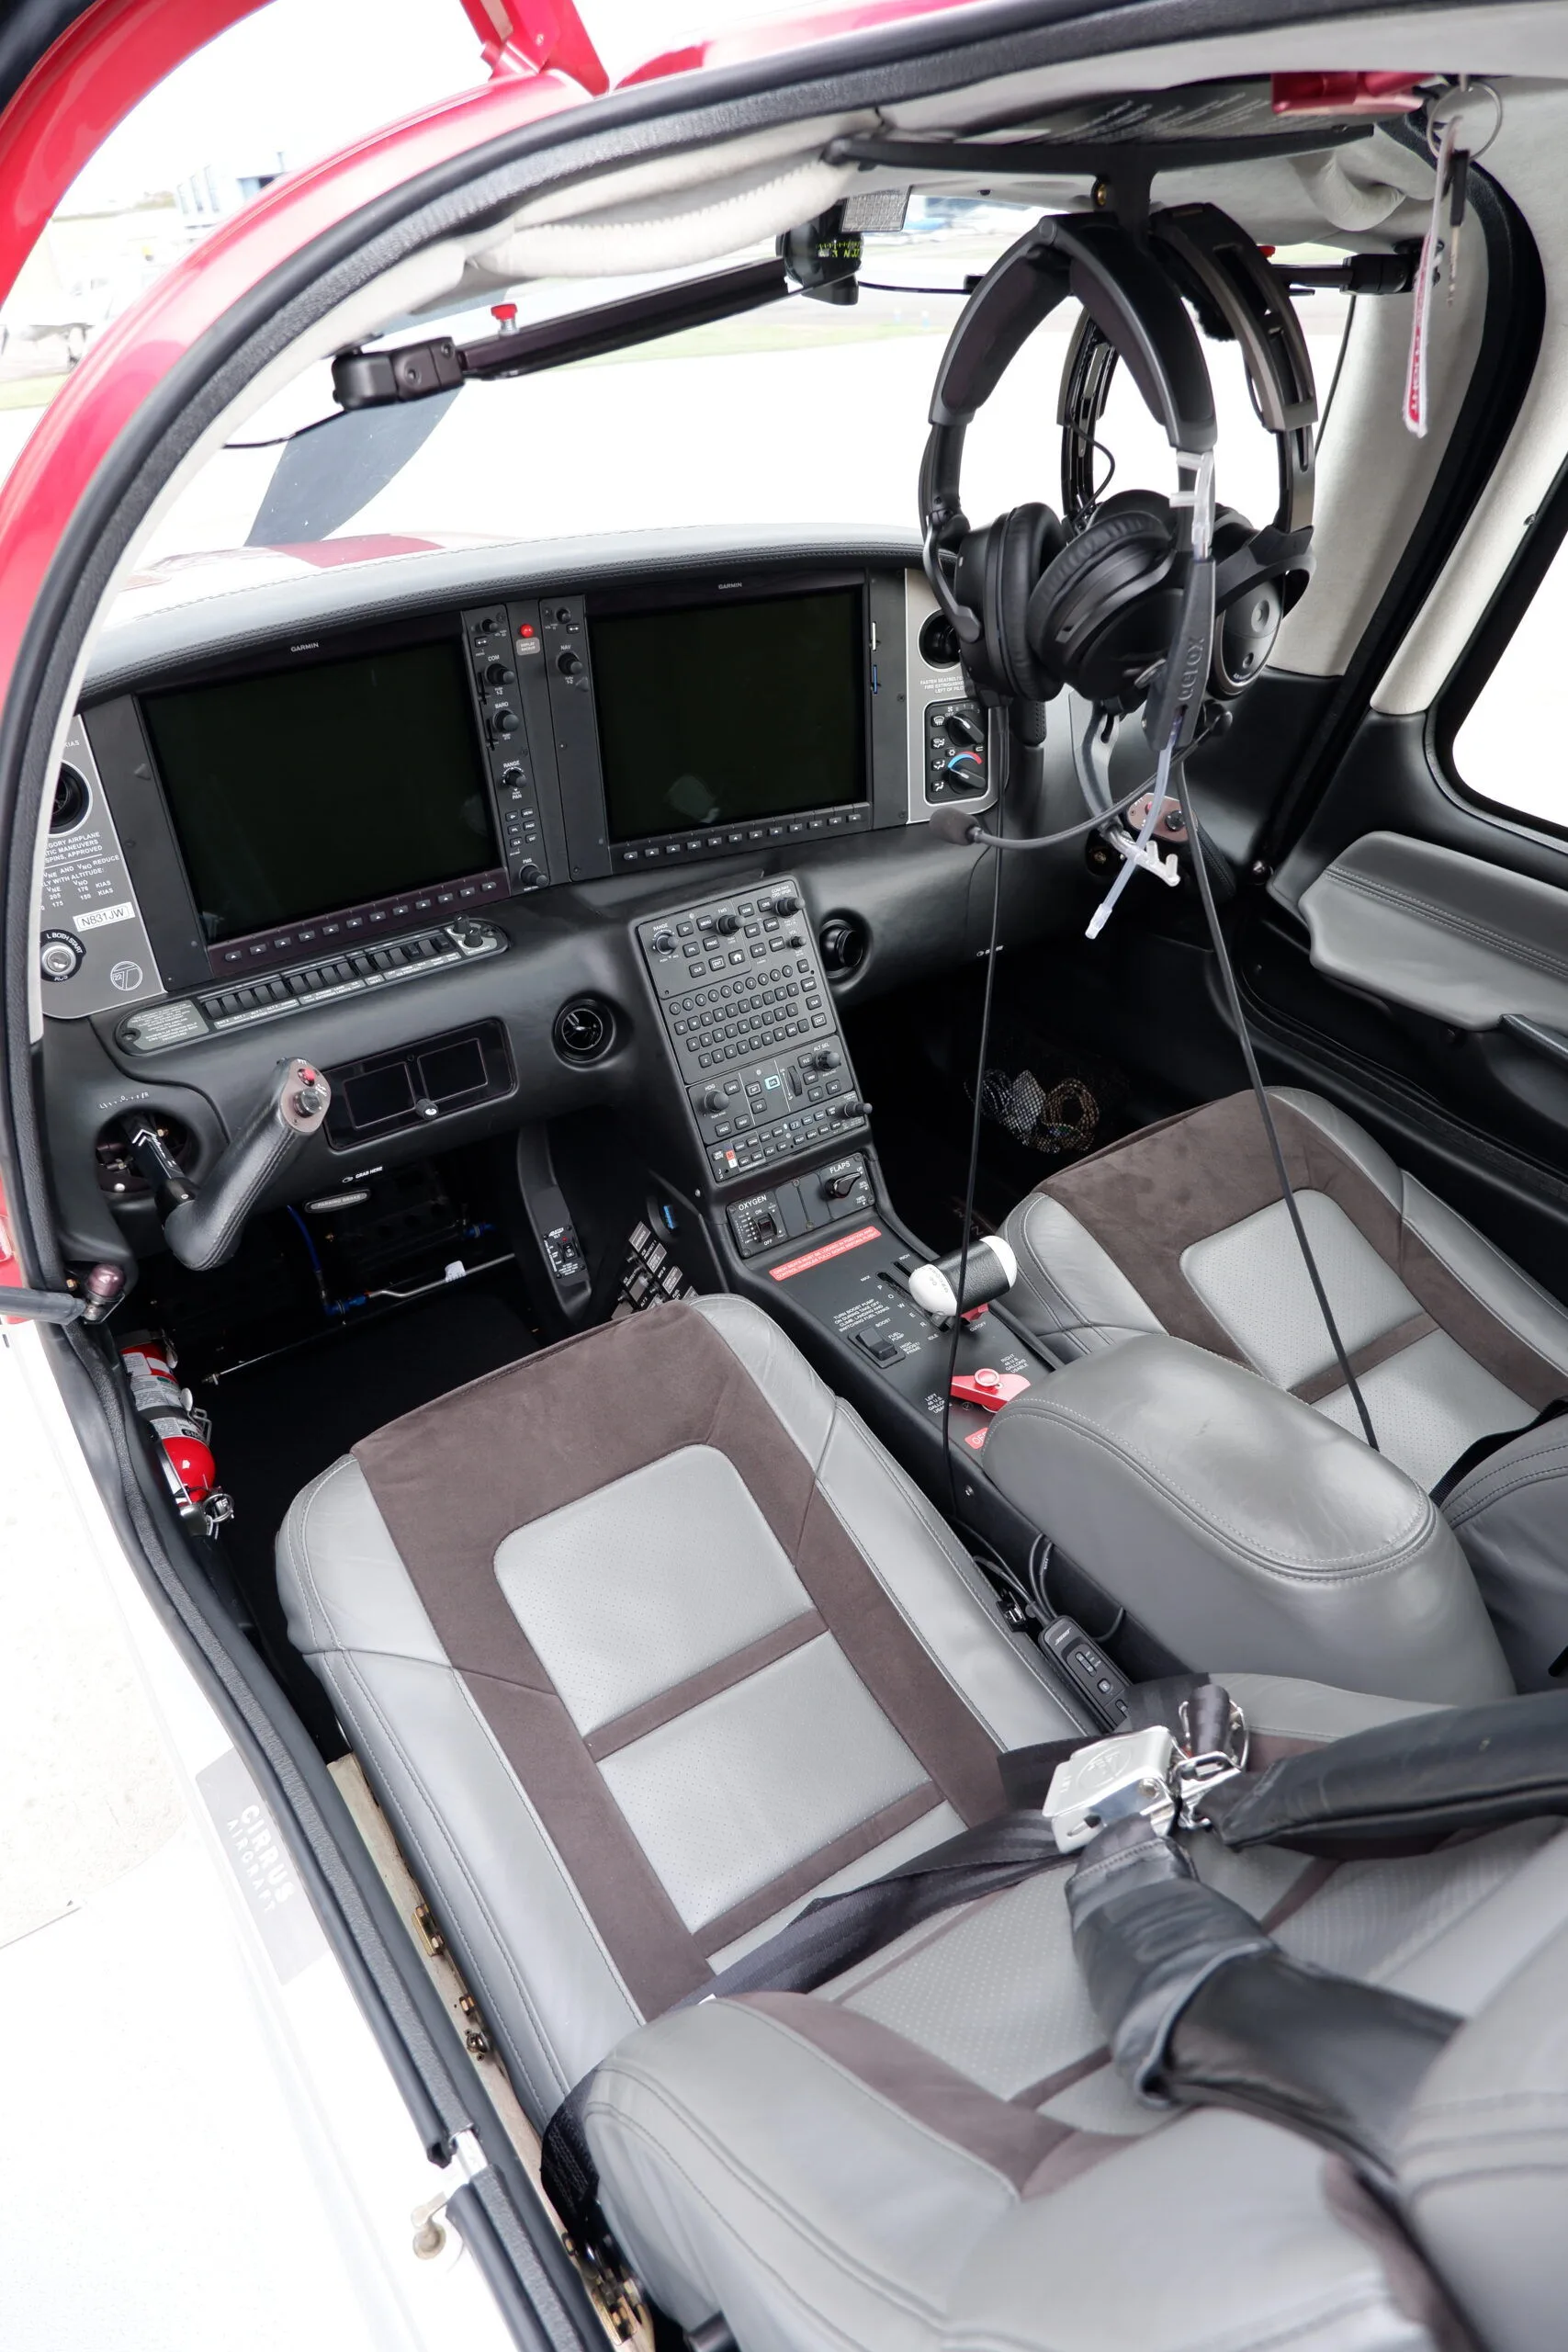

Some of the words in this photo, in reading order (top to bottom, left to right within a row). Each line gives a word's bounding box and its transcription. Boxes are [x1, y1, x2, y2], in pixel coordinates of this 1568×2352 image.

[291, 642, 319, 652] GARMIN
[47, 840, 66, 849] GORY
[68, 832, 100, 843] AIRPLANE
[58, 839, 99, 853] MANEUVERS
[68, 845, 102, 858] APPROVED
[93, 855, 119, 865] REDUCE
[52, 876, 70, 884] WITH
[71, 868, 104, 880] ALTITUDE:
[95, 880, 111, 888] KIAS
[81, 909, 123, 926] N831JW
[653, 923, 668, 931] RANGE
[68, 938, 83, 954] START
[830, 1161, 850, 1174] FLAPS
[738, 1195, 767, 1211] OXYGEN
[846, 1305, 862, 1314] BOOST
[854, 1309, 874, 1320] LANDING
[839, 1320, 864, 1332] SWITCHING
[875, 1306, 890, 1315] TANKS
[842, 1311, 860, 1321] DURING
[875, 1318, 891, 1328] BOOST
[970, 1321, 986, 1332] CUTOFF
[892, 1333, 904, 1342] PUMP
[1000, 1354, 1015, 1362] RIGHT
[1005, 1359, 1027, 1371] GALLONS
[1011, 1364, 1029, 1373] USABLE
[925, 1393, 937, 1401] LEFT
[241, 1805, 294, 1904] CIRRUS
[227, 1819, 275, 1914] AIRCRAFT
